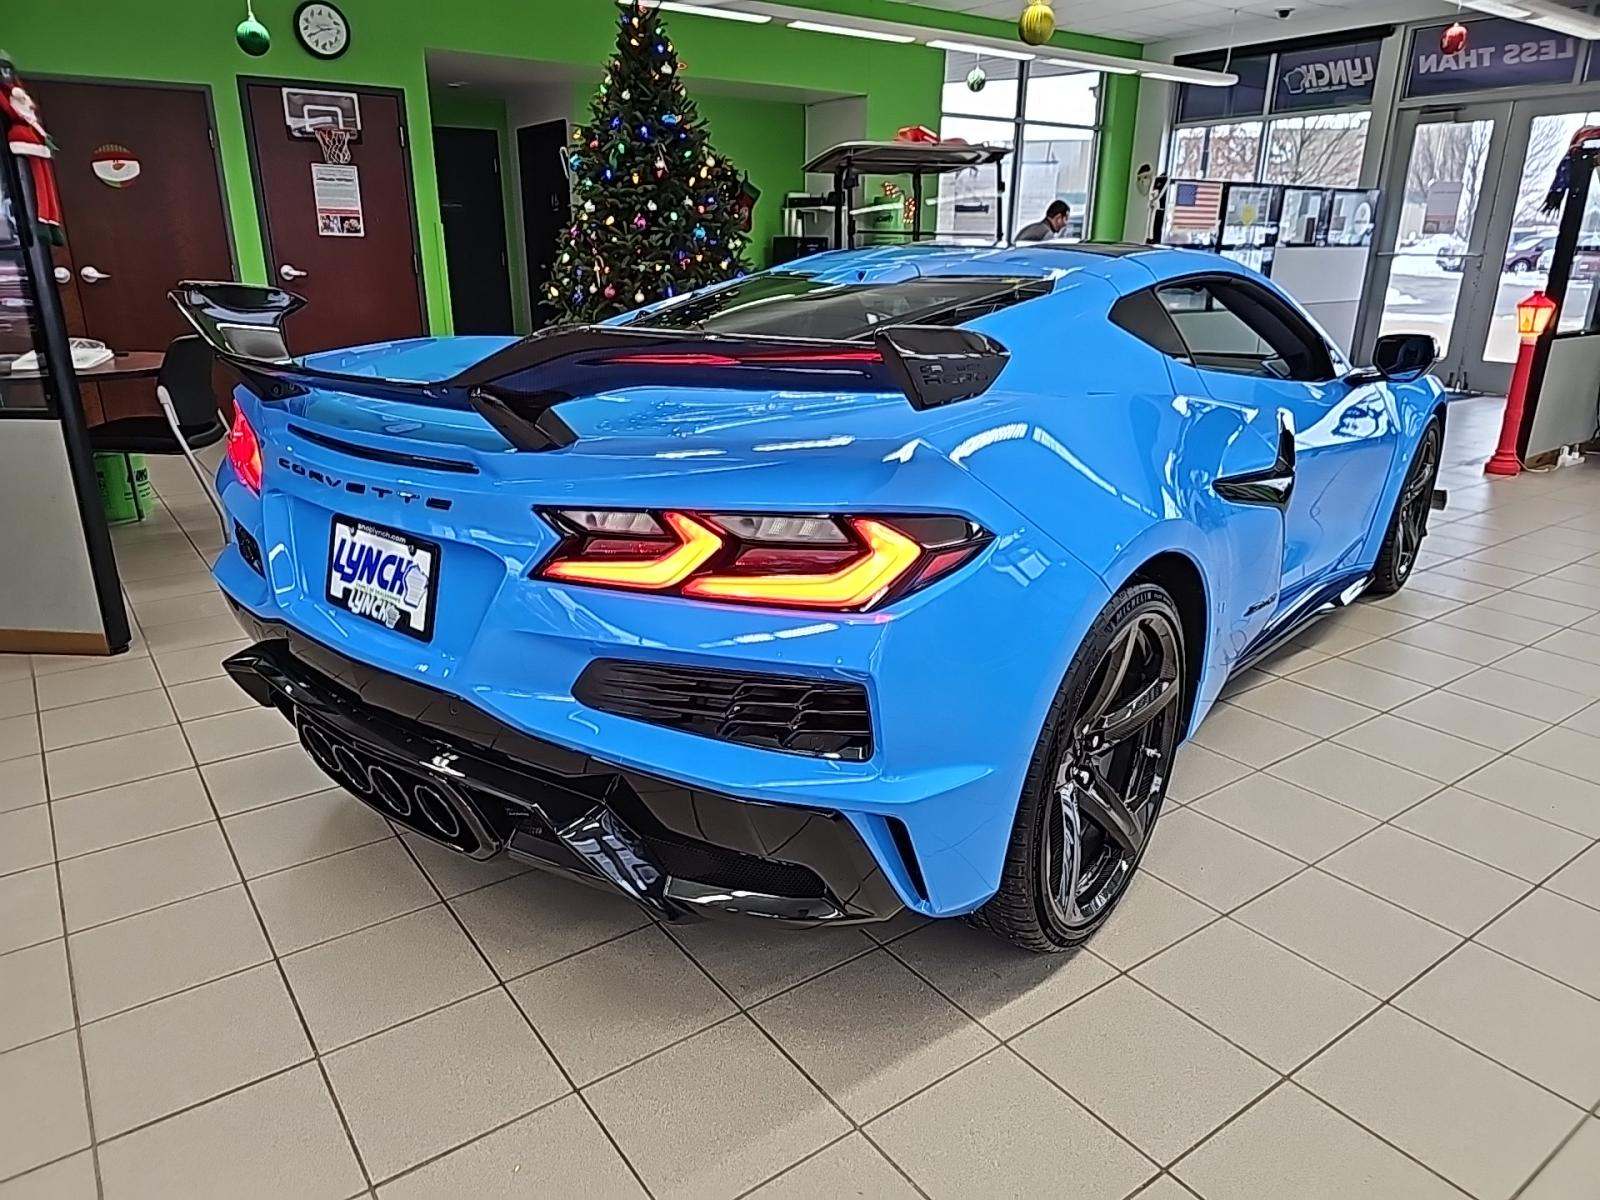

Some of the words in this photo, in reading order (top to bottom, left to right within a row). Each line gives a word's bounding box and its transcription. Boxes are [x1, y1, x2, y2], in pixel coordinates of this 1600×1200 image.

[278, 457, 452, 510] CORVETTE
[333, 537, 413, 596] LYNCH
[347, 588, 391, 622] LYNCH
